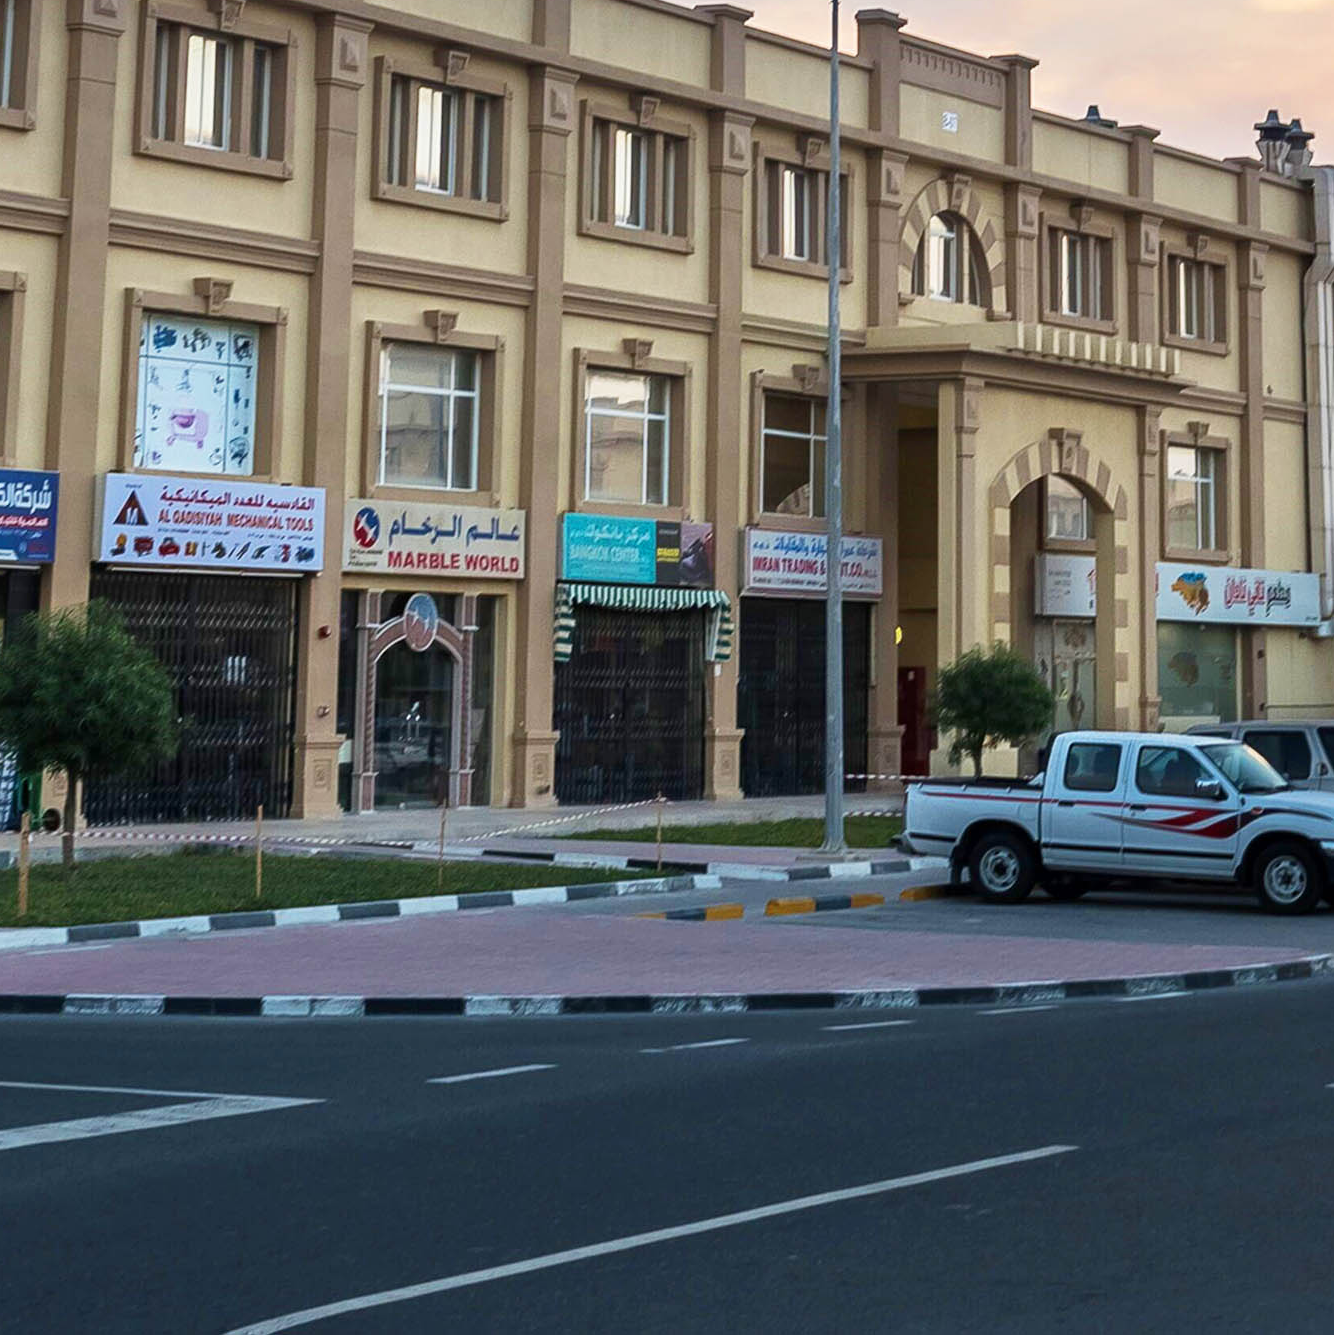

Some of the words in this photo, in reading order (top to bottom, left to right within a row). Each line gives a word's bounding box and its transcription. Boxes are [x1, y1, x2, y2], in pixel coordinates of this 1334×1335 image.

[15, 479, 53, 514] شركة
[157, 508, 171, 523] AL
[172, 509, 223, 526] QADISIYAH
[226, 512, 283, 530] MECHANICAL
[284, 517, 314, 532] TOOLS
[388, 510, 463, 546] الرخام
[466, 517, 520, 546] عالم
[387, 550, 461, 570] MARBLE
[465, 554, 519, 573] WORLD
[753, 556, 780, 573] IMRAN
[781, 557, 818, 576] TRADING
